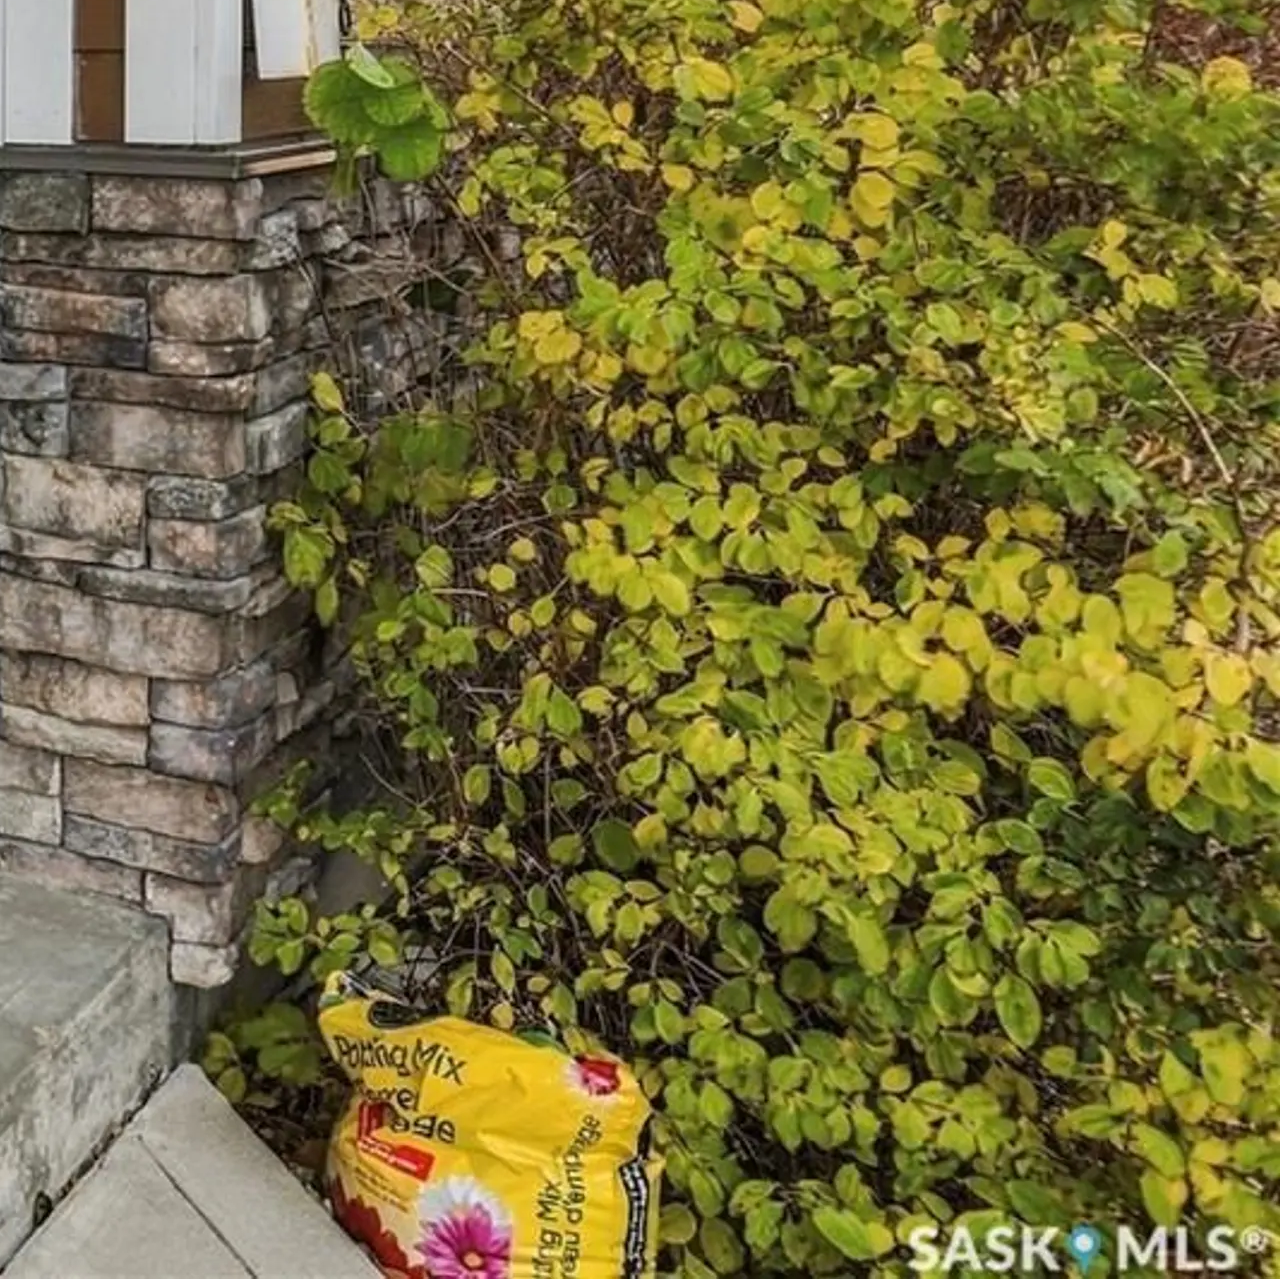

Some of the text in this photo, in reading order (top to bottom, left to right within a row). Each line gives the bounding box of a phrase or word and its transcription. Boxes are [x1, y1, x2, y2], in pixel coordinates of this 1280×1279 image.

[333, 1034, 467, 1085] Potting Mix
[536, 1180, 563, 1222] Mix
